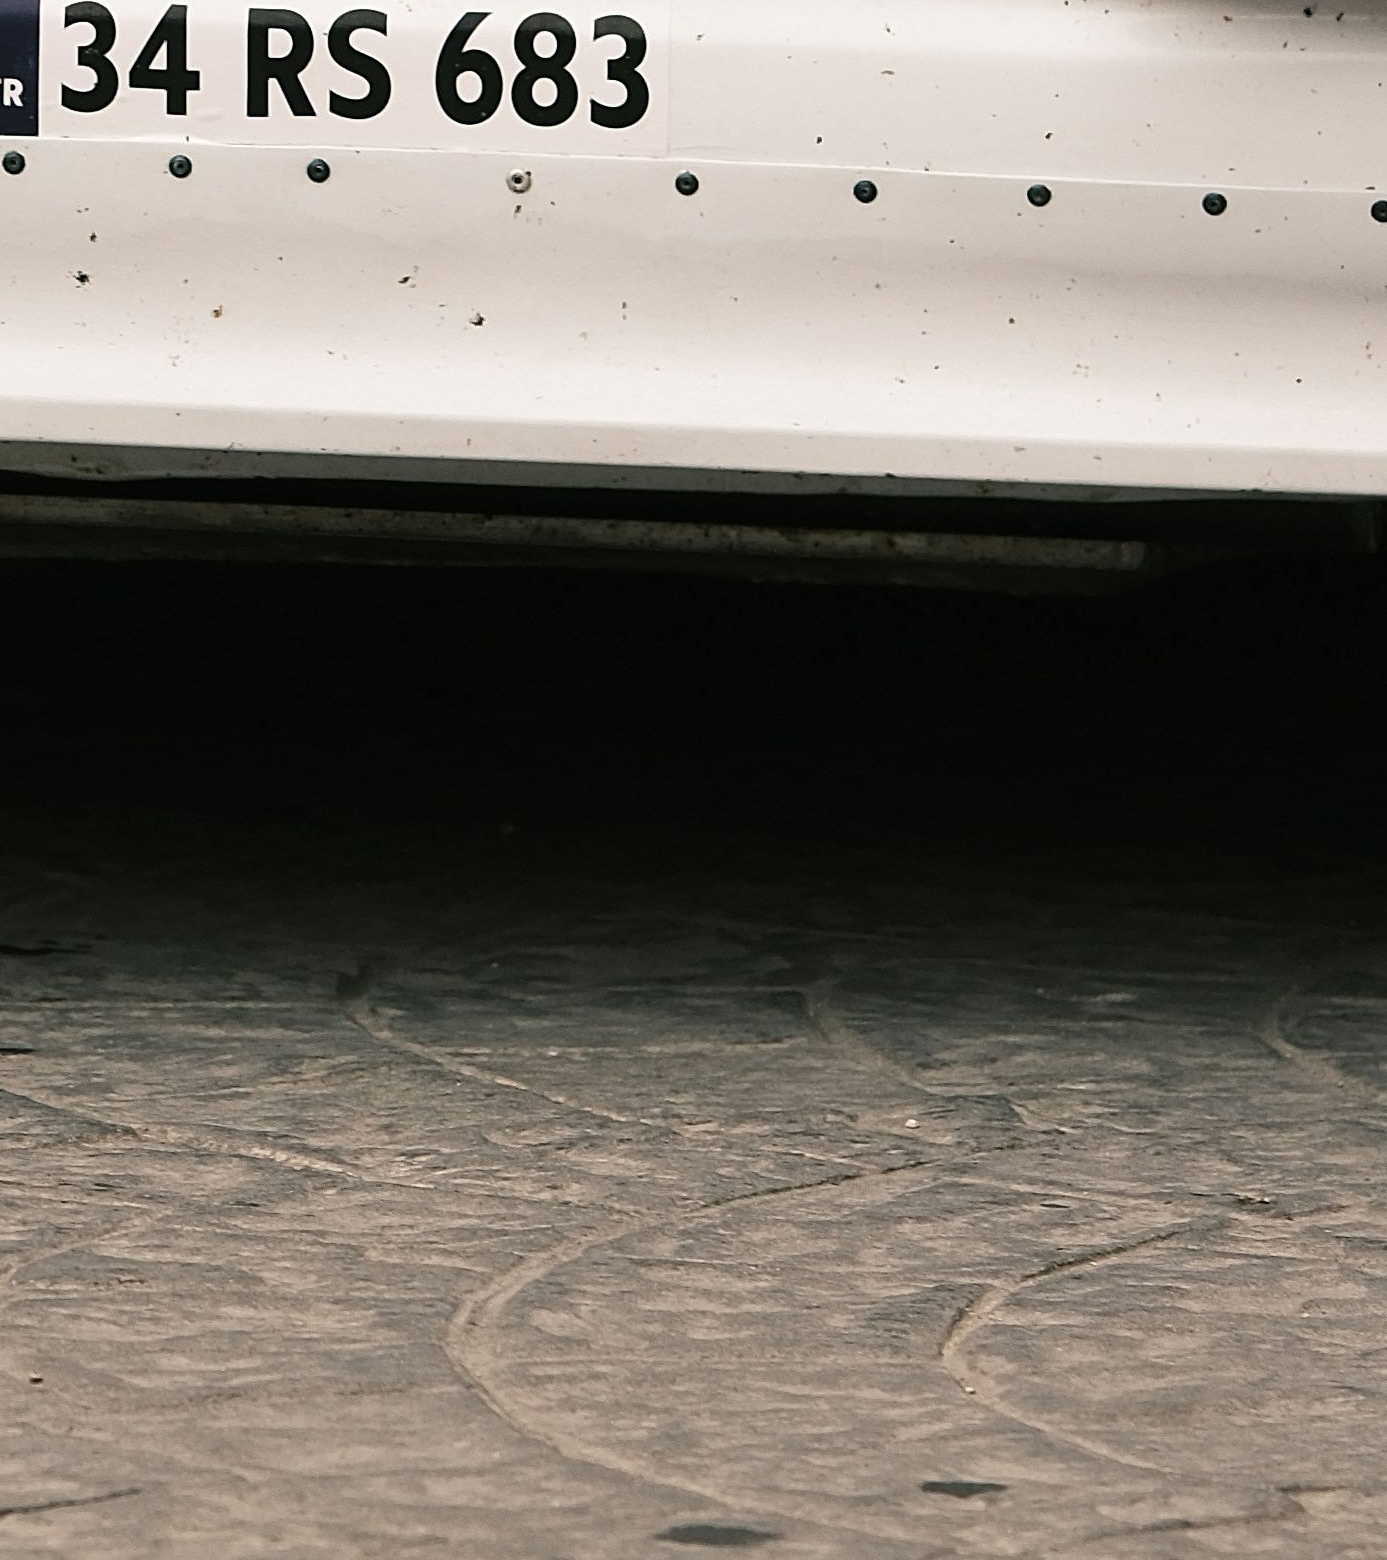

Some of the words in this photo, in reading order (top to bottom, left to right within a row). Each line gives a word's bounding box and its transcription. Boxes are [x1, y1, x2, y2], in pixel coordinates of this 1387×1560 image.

[61, 1, 200, 115] 34
[247, 8, 391, 119] RS
[435, 11, 650, 129] 683
